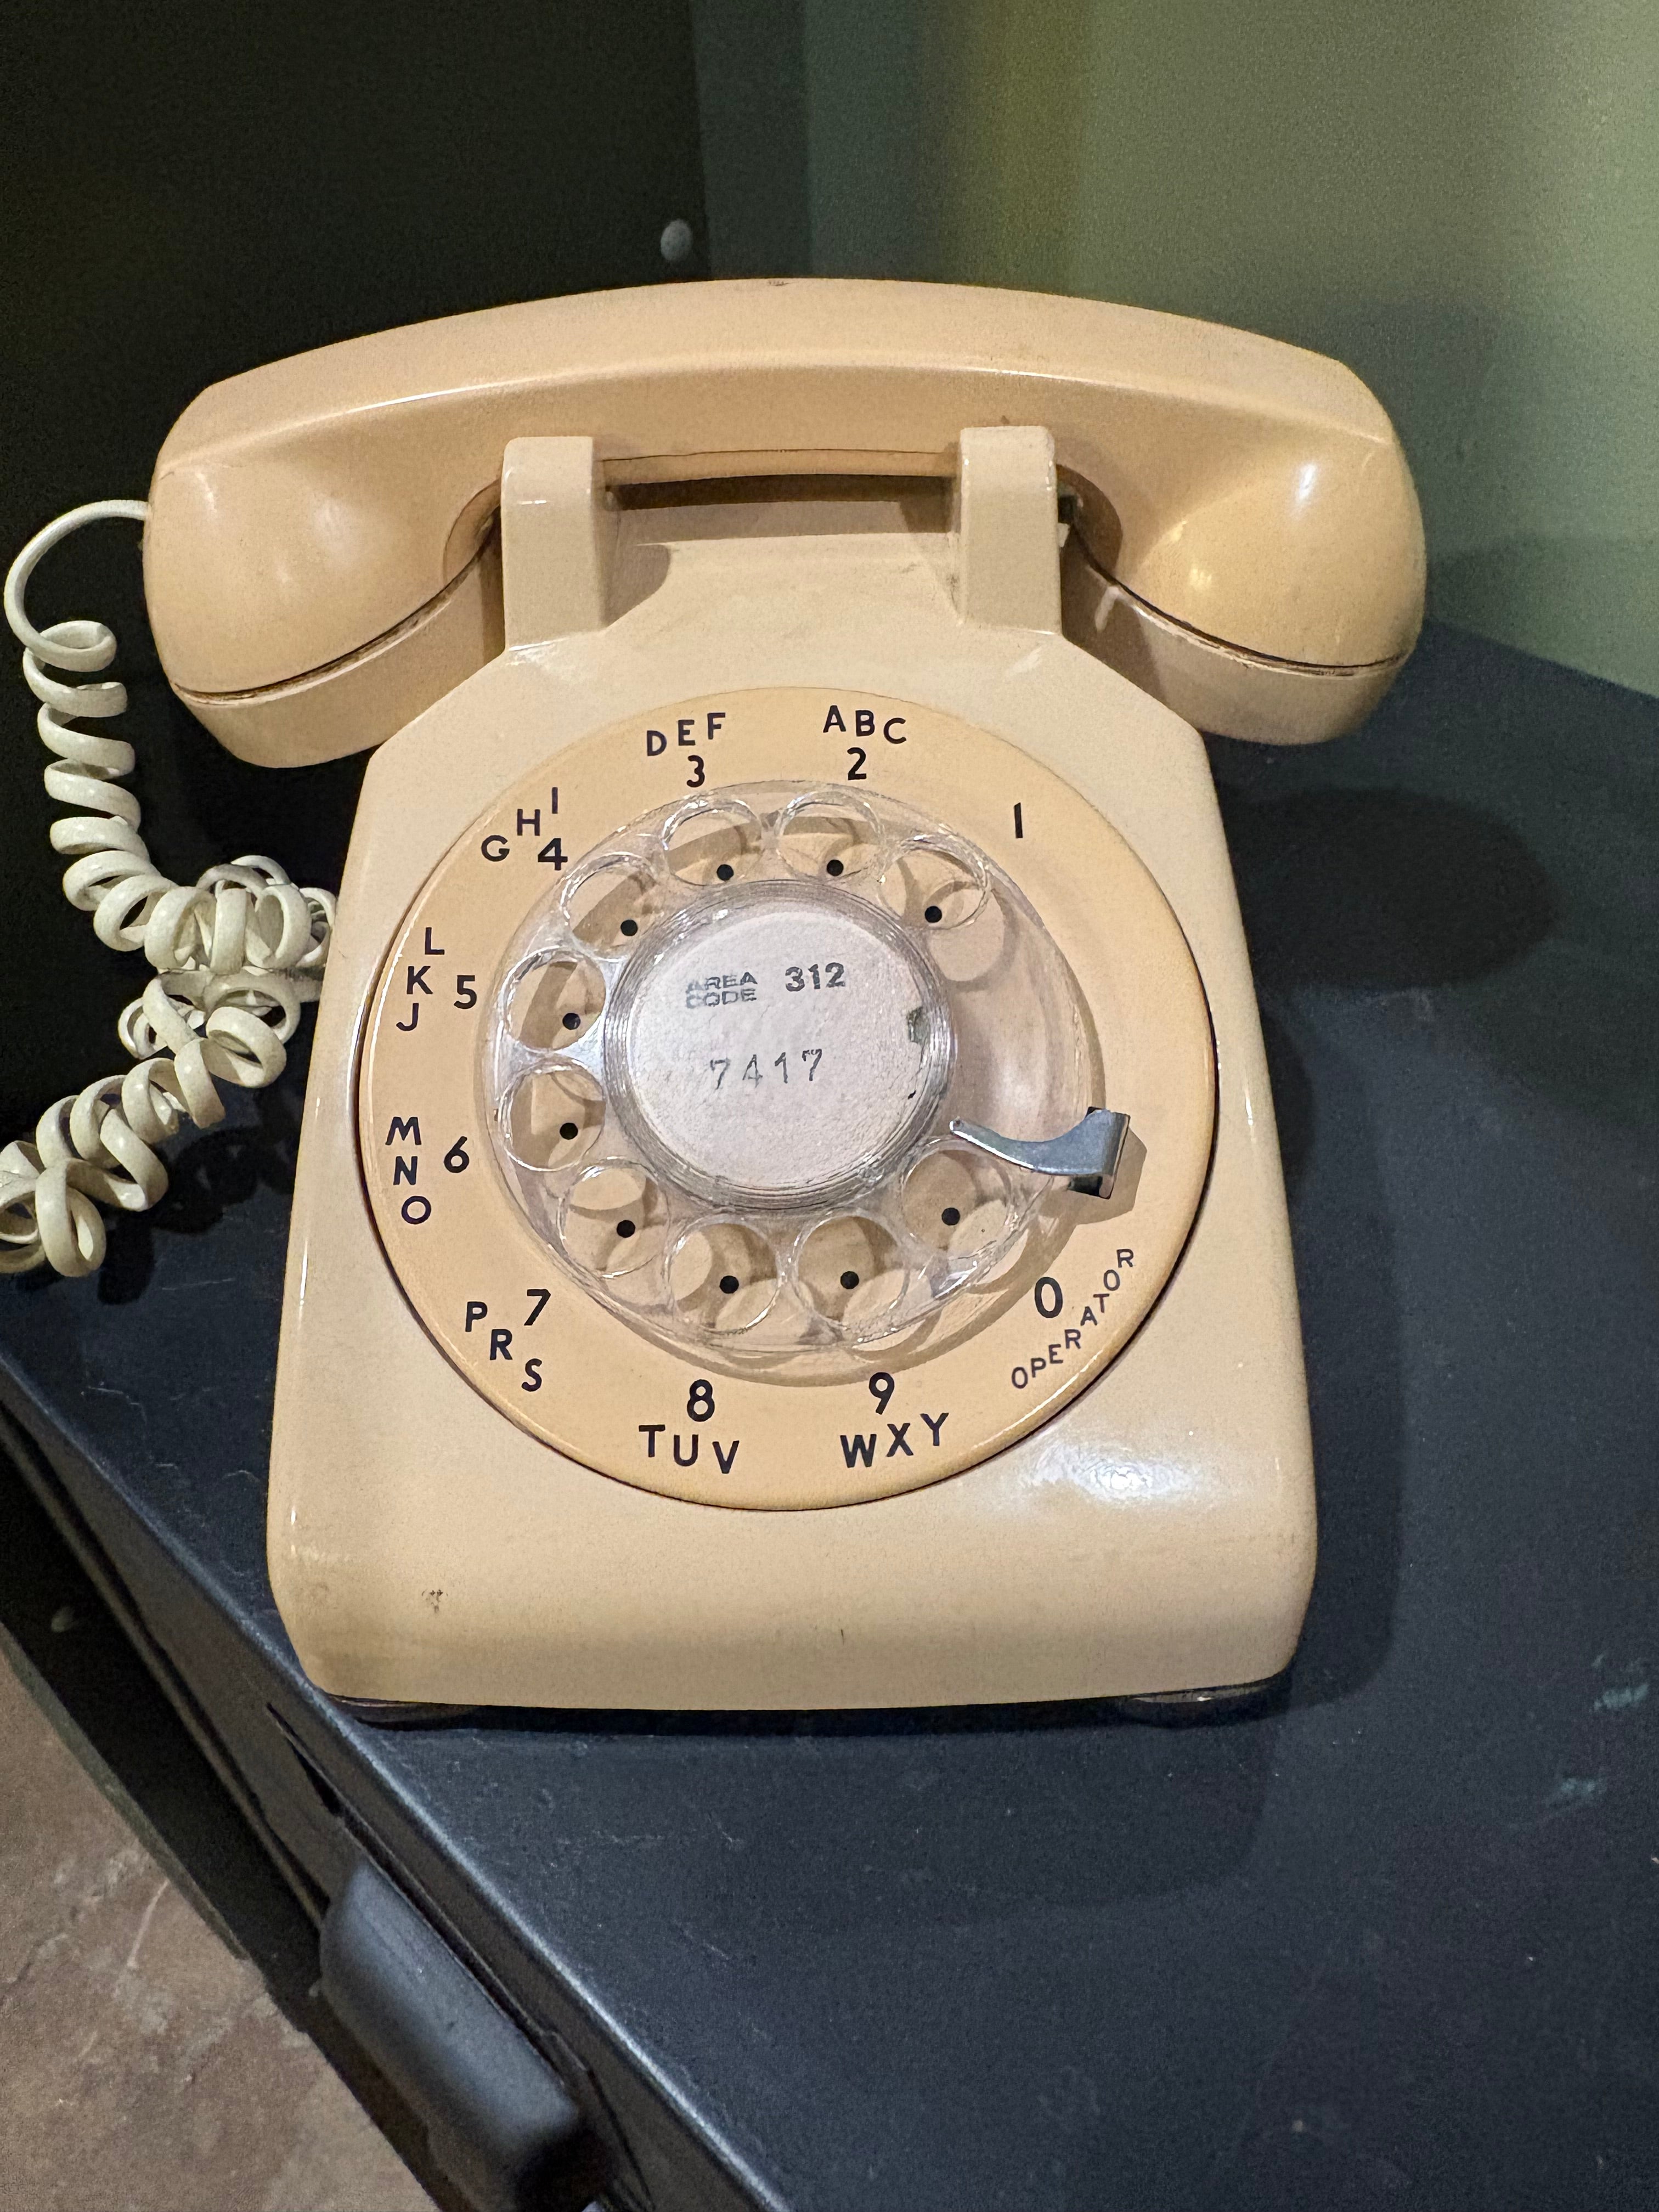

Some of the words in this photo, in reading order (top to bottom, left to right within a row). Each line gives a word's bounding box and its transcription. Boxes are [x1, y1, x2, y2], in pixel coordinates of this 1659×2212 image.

[686, 755, 706, 788] 3
[847, 747, 867, 781] 2
[538, 838, 568, 871] 4
[454, 975, 477, 1009] 5
[687, 972, 758, 991] AREA
[785, 962, 845, 992] 312
[686, 988, 757, 1009] CODE
[710, 1048, 823, 1090] 7417
[444, 1136, 470, 1173] 6
[524, 1289, 551, 1326] 7
[1034, 1277, 1063, 1318] 0
[1011, 1249, 1134, 1389] OPERATOR
[687, 1379, 715, 1422] 8
[868, 1372, 895, 1415] 9
